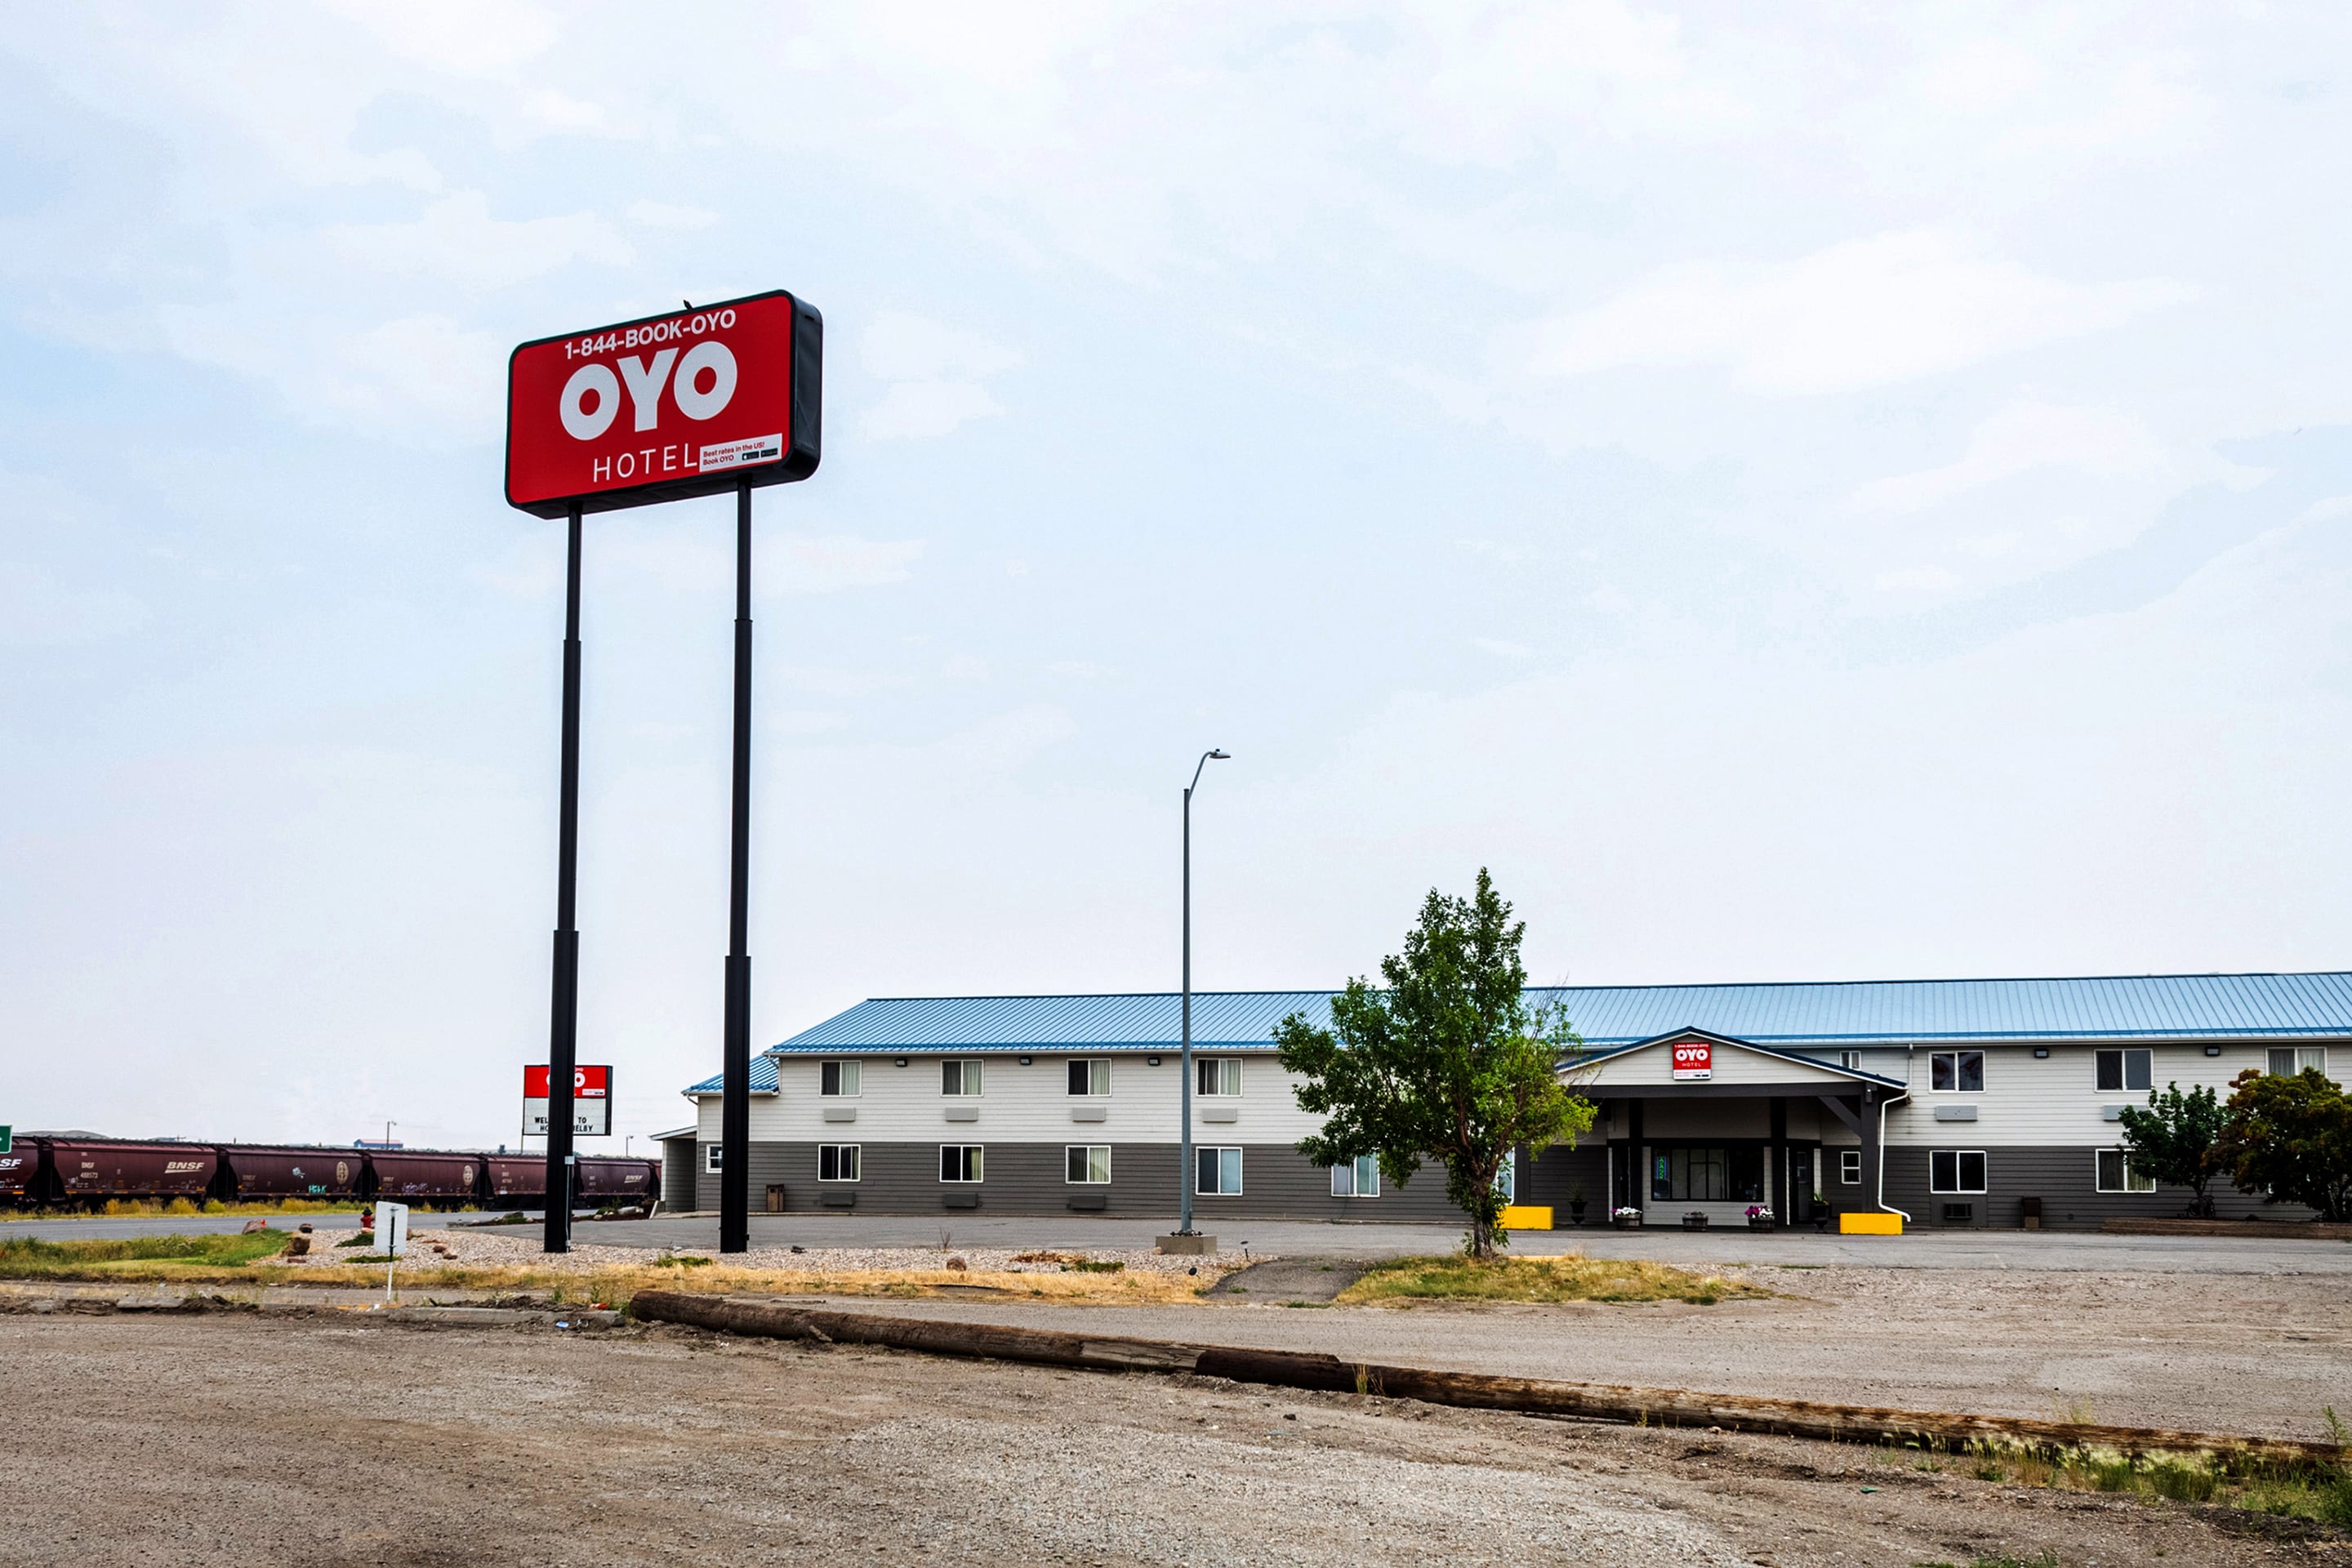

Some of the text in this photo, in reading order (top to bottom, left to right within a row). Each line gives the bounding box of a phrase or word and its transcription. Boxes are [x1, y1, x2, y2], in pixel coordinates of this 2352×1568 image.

[565, 309, 737, 359] 1-844-BOOK-OYO
[559, 341, 737, 440] OYO
[703, 450, 718, 458] Best
[742, 443, 753, 452] the
[754, 441, 765, 449] US!
[593, 443, 697, 483] HOTEL
[719, 455, 734, 463] OYO
[1675, 1049, 1708, 1062] OYO
[0, 1158, 22, 1167] SF
[167, 1161, 204, 1169] BNSF
